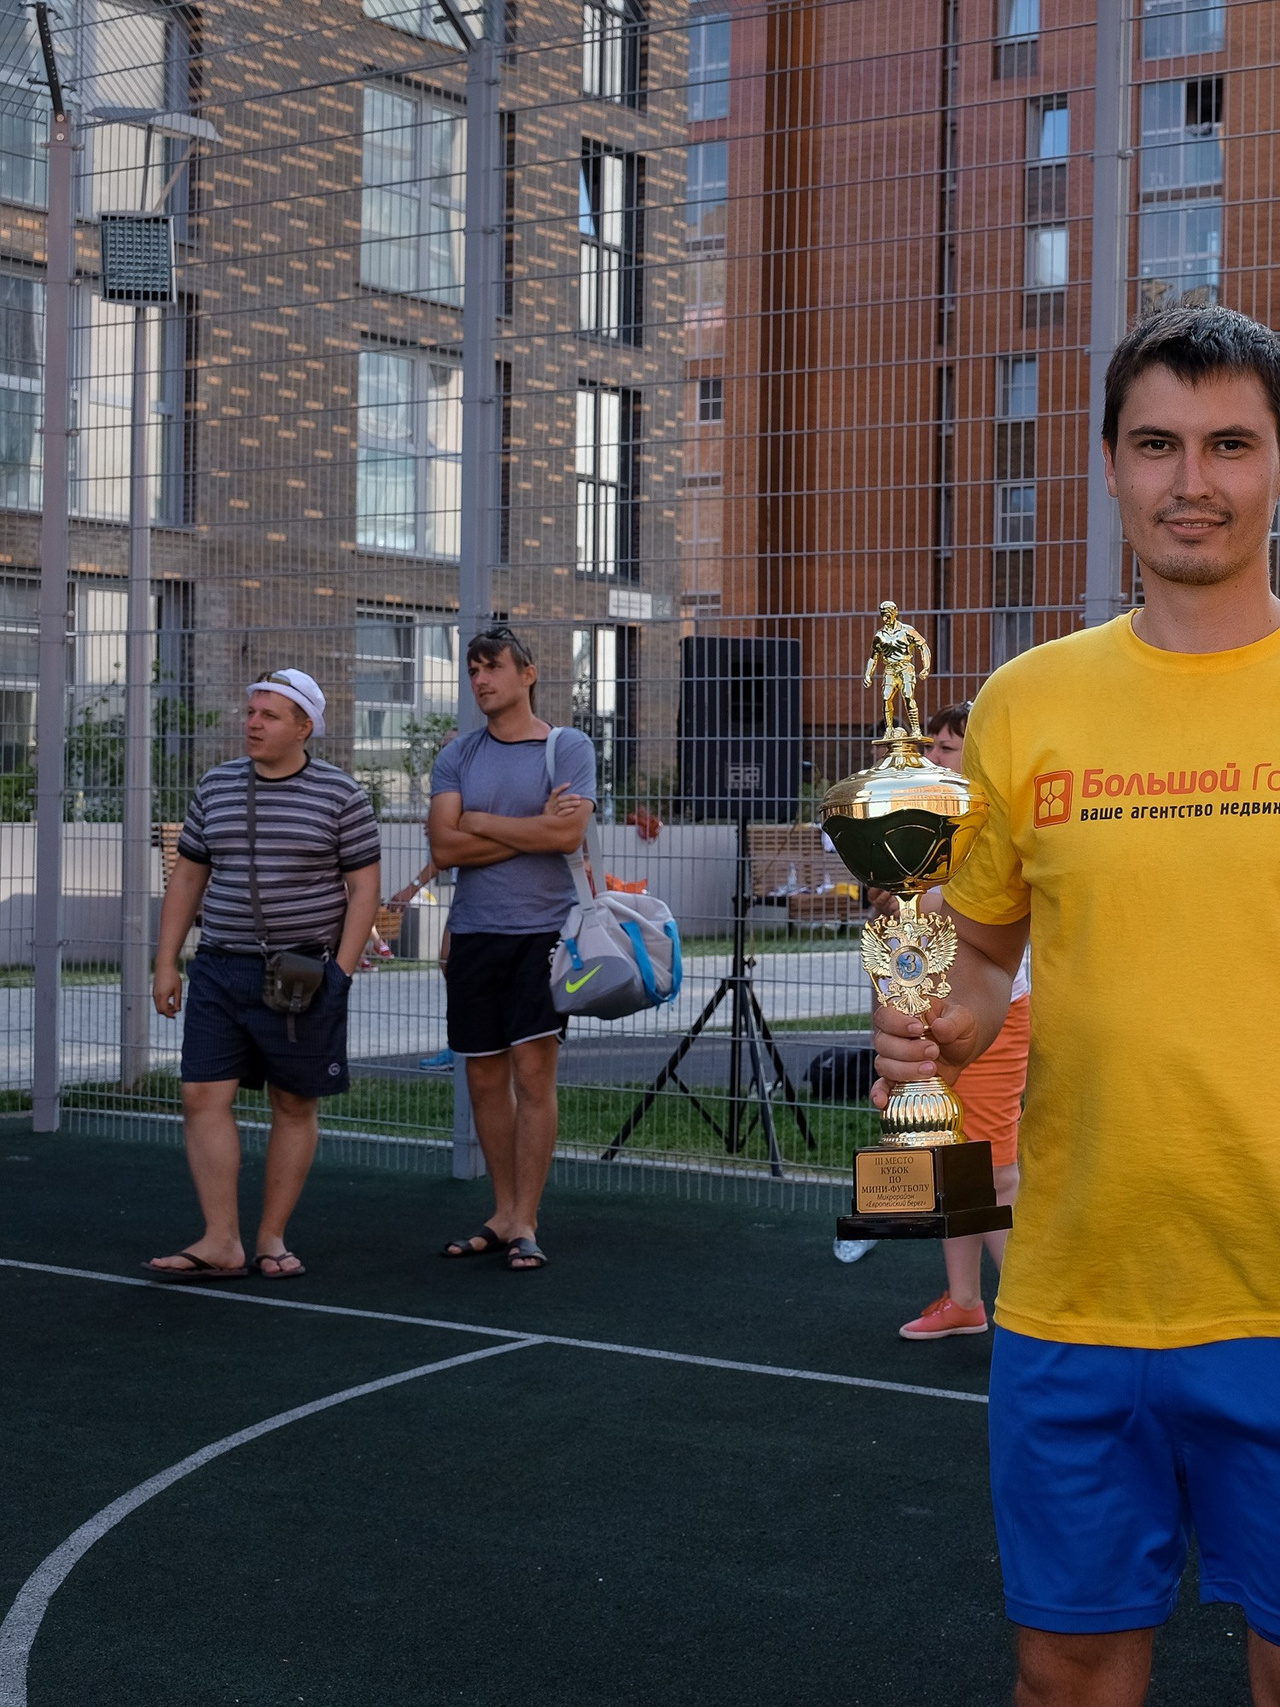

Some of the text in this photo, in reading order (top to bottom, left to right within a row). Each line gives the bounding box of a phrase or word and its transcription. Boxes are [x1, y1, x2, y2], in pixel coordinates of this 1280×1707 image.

[1081, 762, 1241, 798] Большой
[1080, 806, 1123, 821] ваше
[1130, 803, 1213, 819] агентство
[904, 954, 916, 973] 3
[874, 1156, 914, 1166] III МЕСТО
[880, 1166, 909, 1175] КУБОК
[889, 1175, 902, 1184] ПО
[861, 1184, 930, 1193] МИНИ-ФУТБОЛУ
[877, 1193, 915, 1201] Микрорайон
